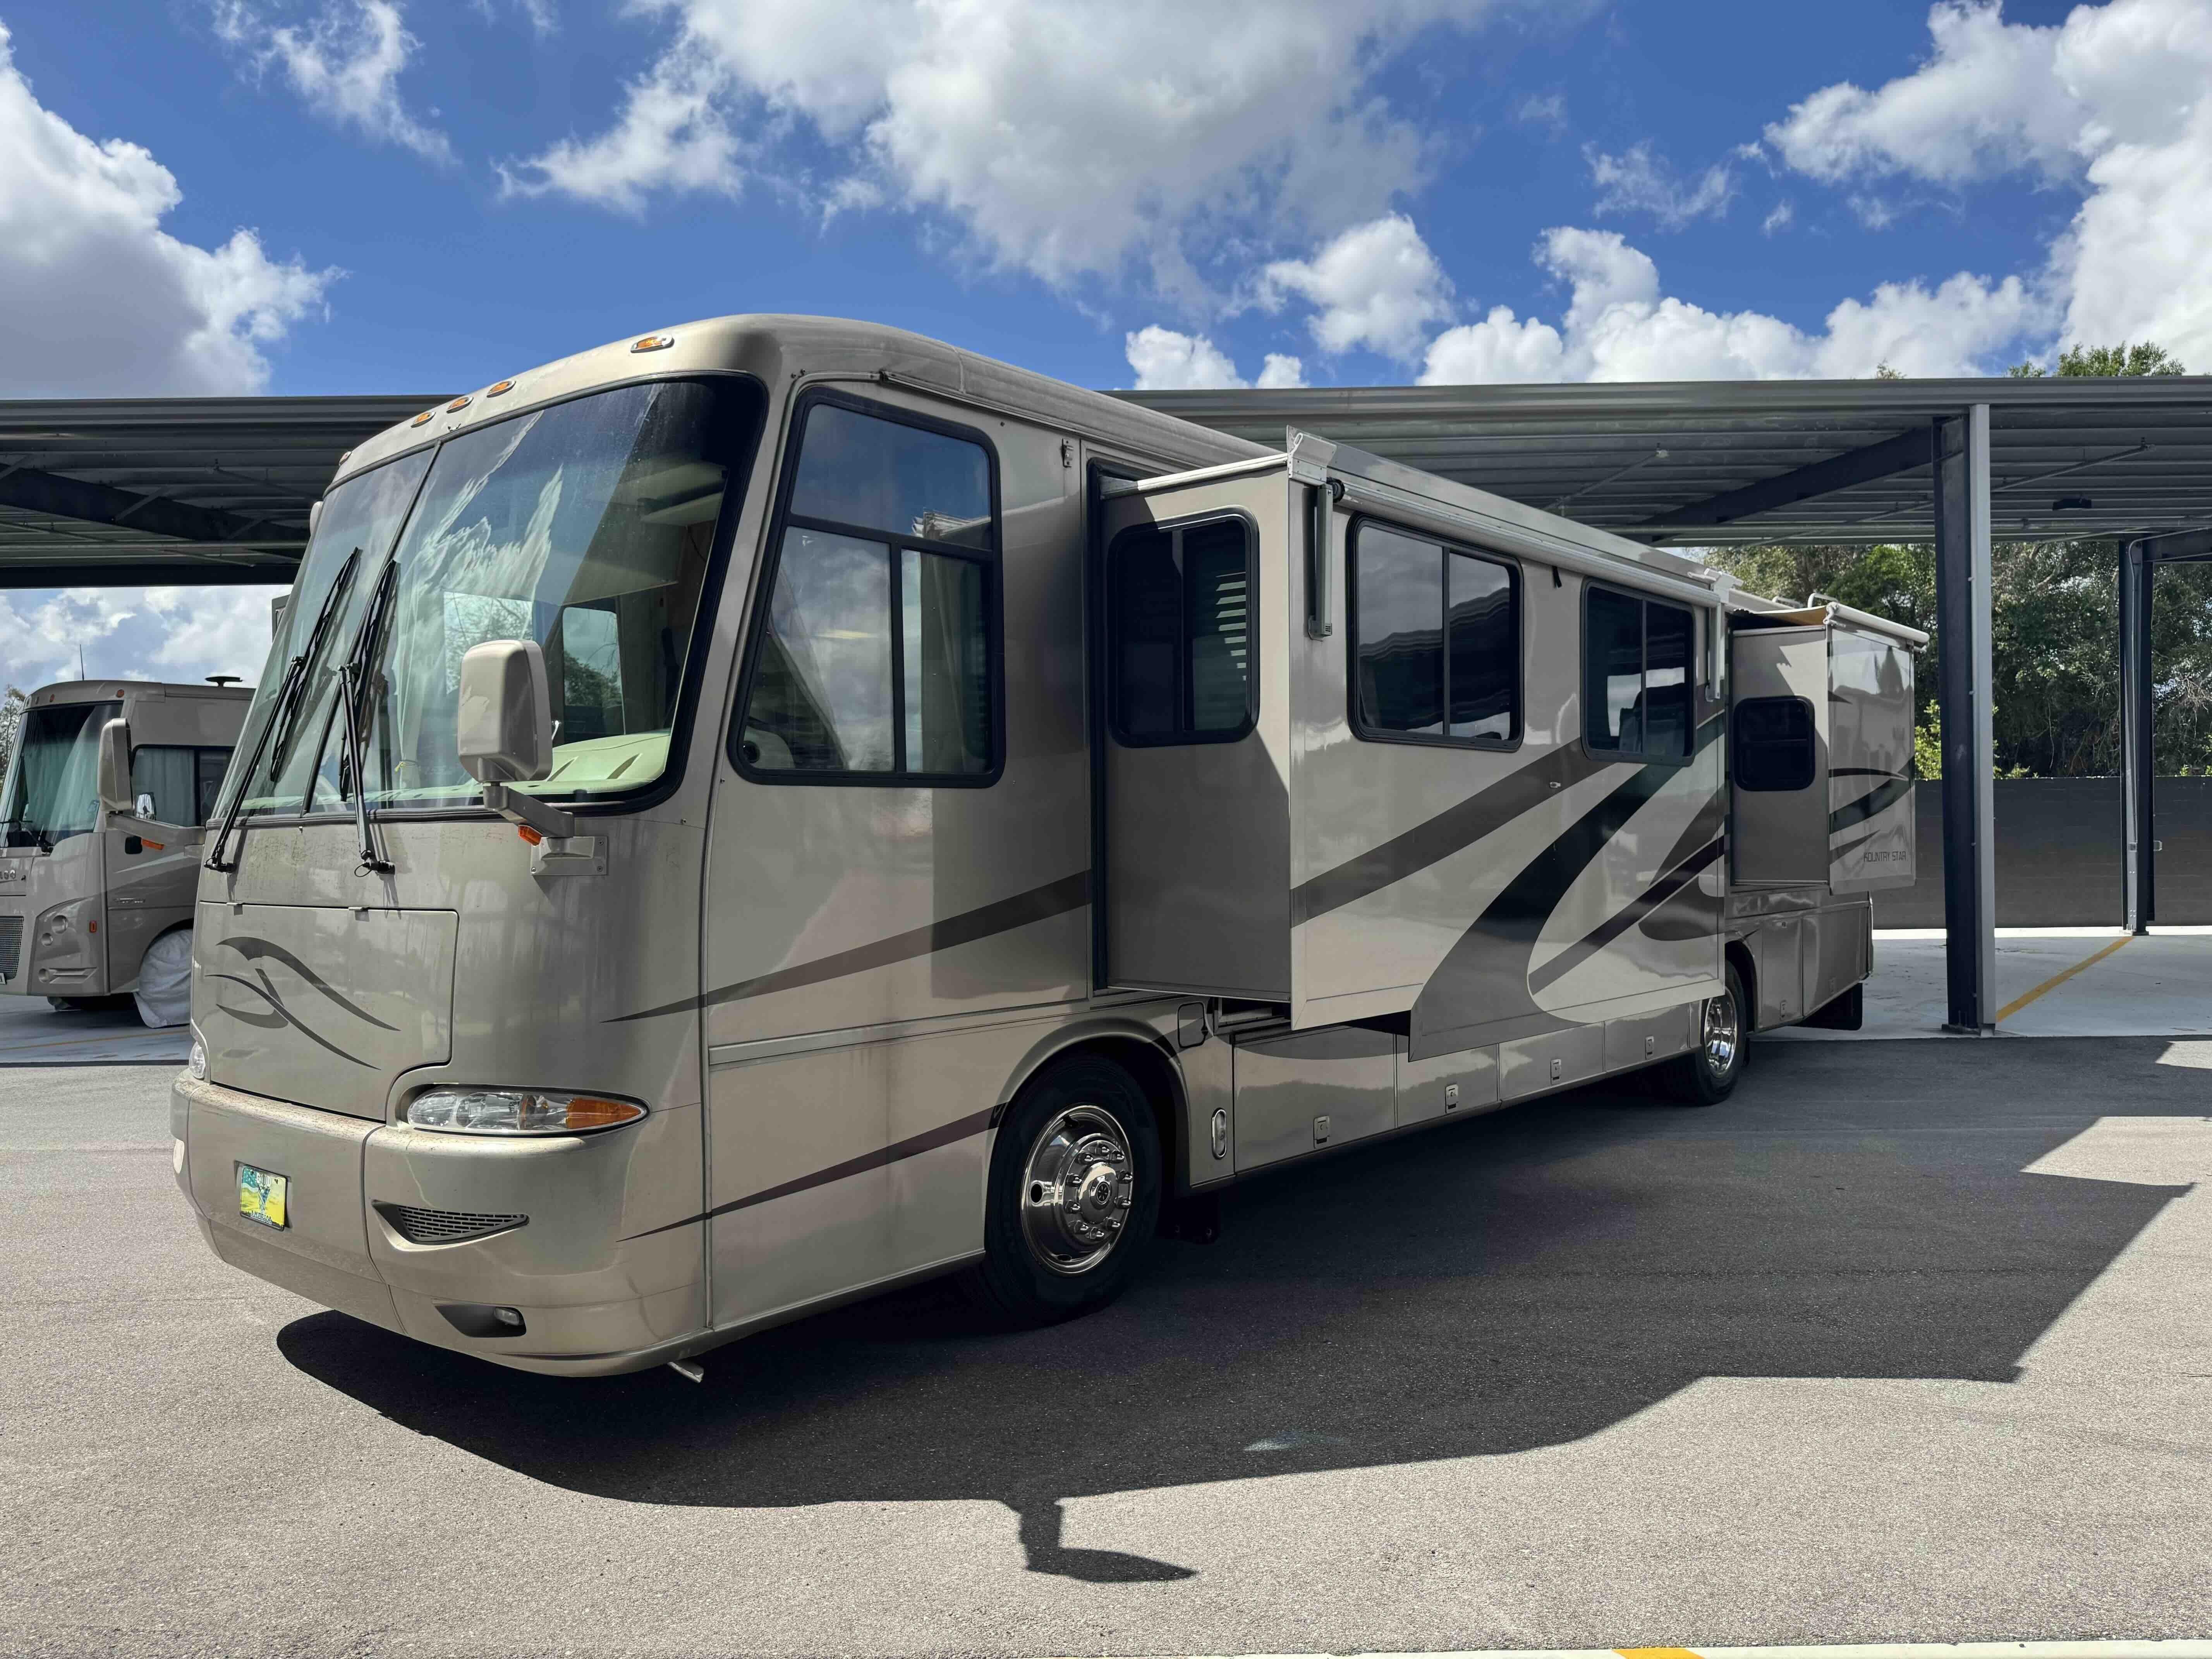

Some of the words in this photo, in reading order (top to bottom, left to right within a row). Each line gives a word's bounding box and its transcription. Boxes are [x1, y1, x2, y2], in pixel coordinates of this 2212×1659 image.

[1864, 852, 1890, 862] KOUNTRY
[1893, 851, 1906, 861] STAR
[256, 1171, 271, 1186] GOD
[251, 1210, 273, 1224] AMERICA
